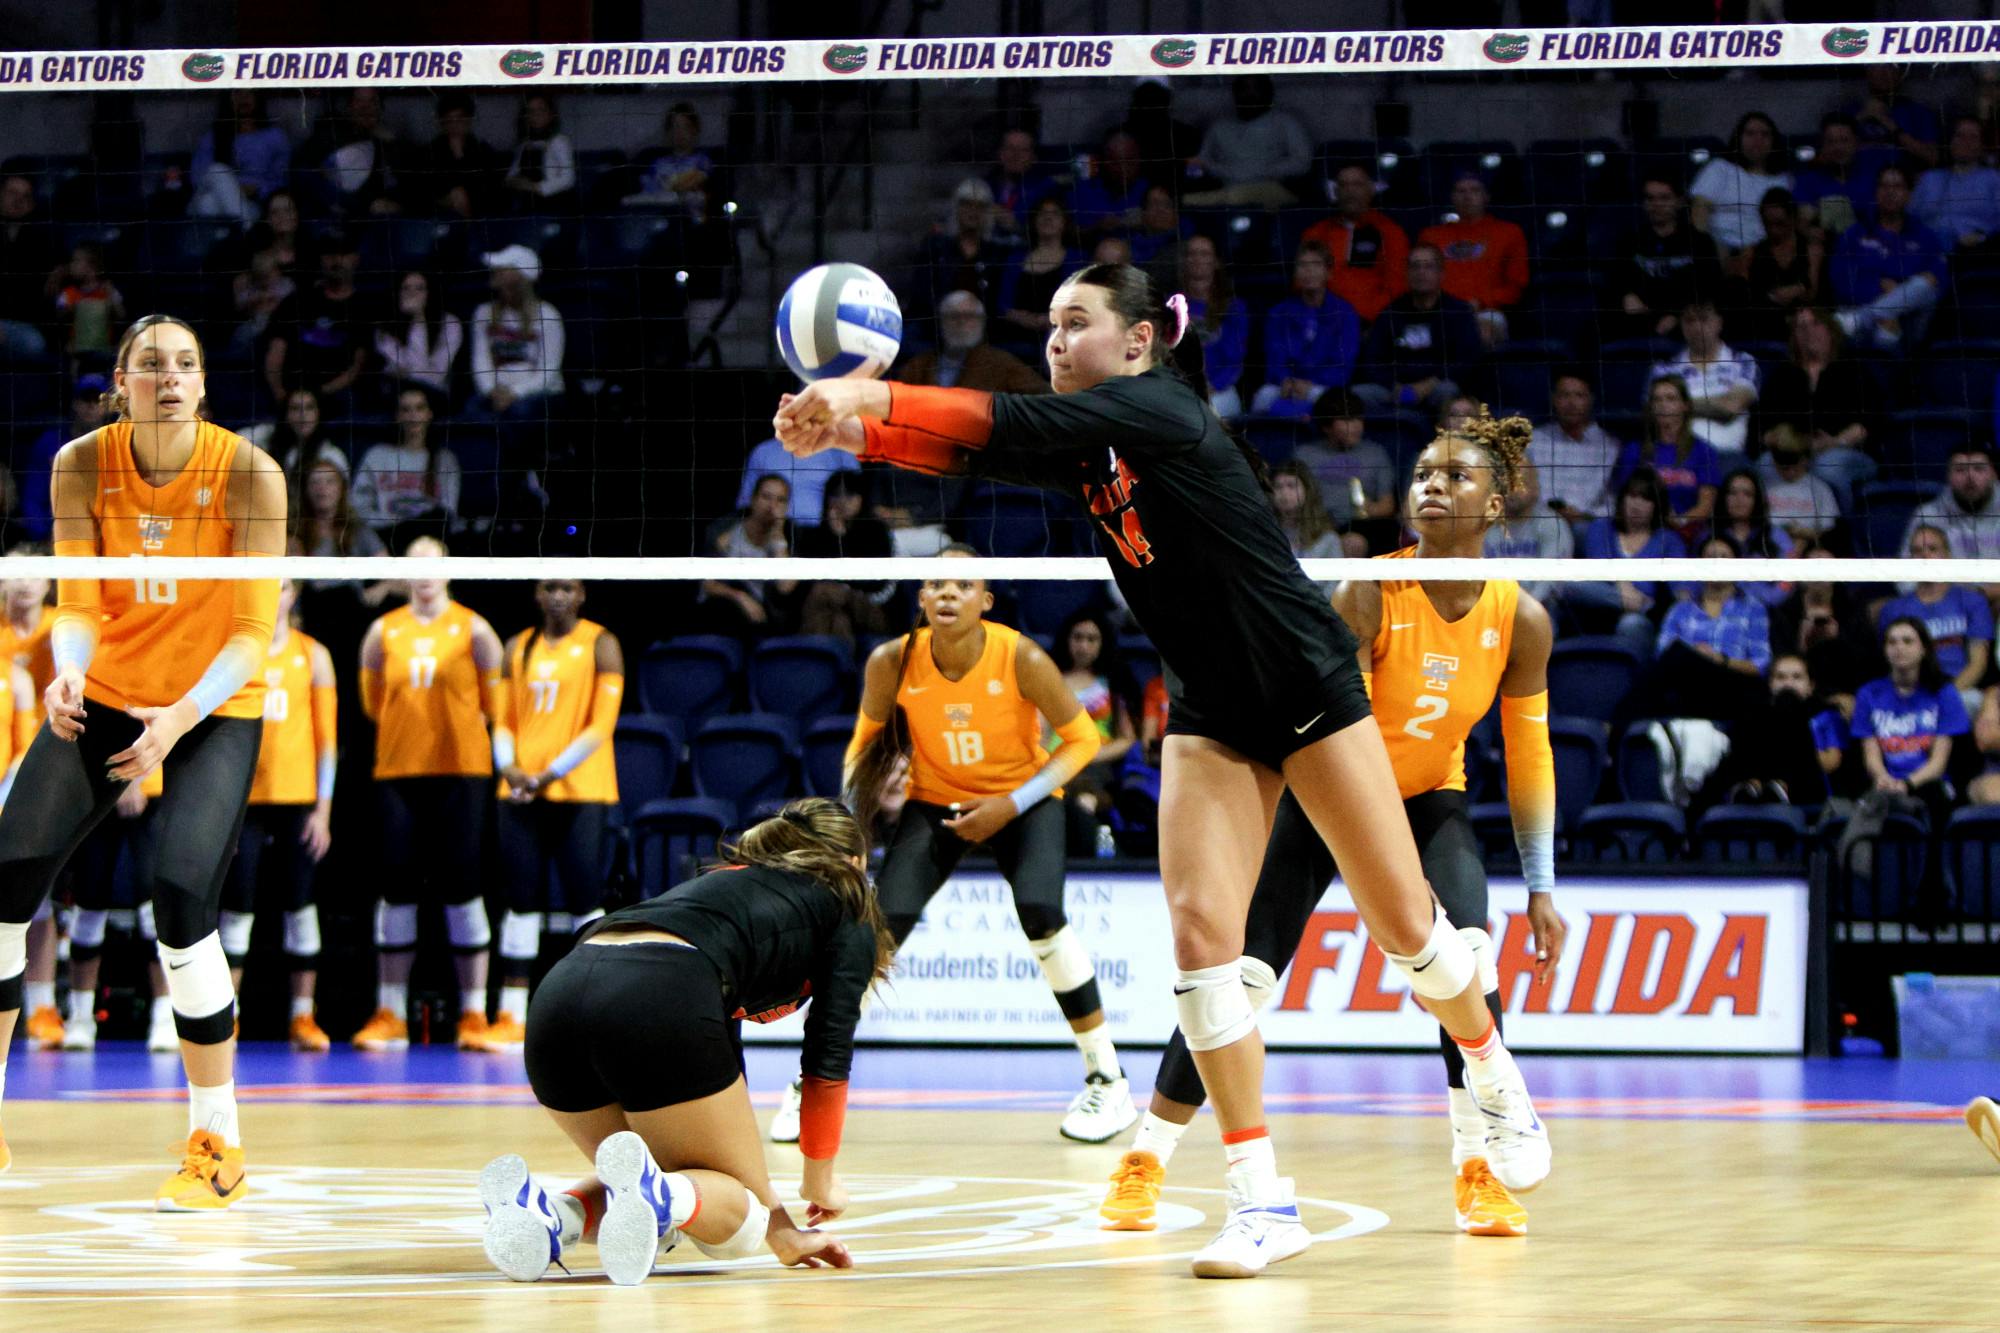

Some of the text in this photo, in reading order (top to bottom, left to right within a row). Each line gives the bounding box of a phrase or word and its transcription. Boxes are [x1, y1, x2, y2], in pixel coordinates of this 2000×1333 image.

[1207, 35, 1445, 65] FLORIDA GATORS
[1539, 30, 1783, 60] FLORIDA GATORS
[1878, 25, 2000, 54] FLORIDA
[41, 55, 145, 82] GATORS
[235, 51, 463, 80] FLORIDA GATORS
[553, 46, 785, 76] FLORIDA GATORS
[878, 41, 1113, 71] FLORIDA GATORS
[1403, 694, 1449, 740] 2
[942, 731, 985, 766] 18
[945, 911, 1111, 931] CAMUS
[895, 952, 999, 981] students
[1006, 952, 1046, 980] lov
[1277, 911, 1769, 1016] FLRIDA
